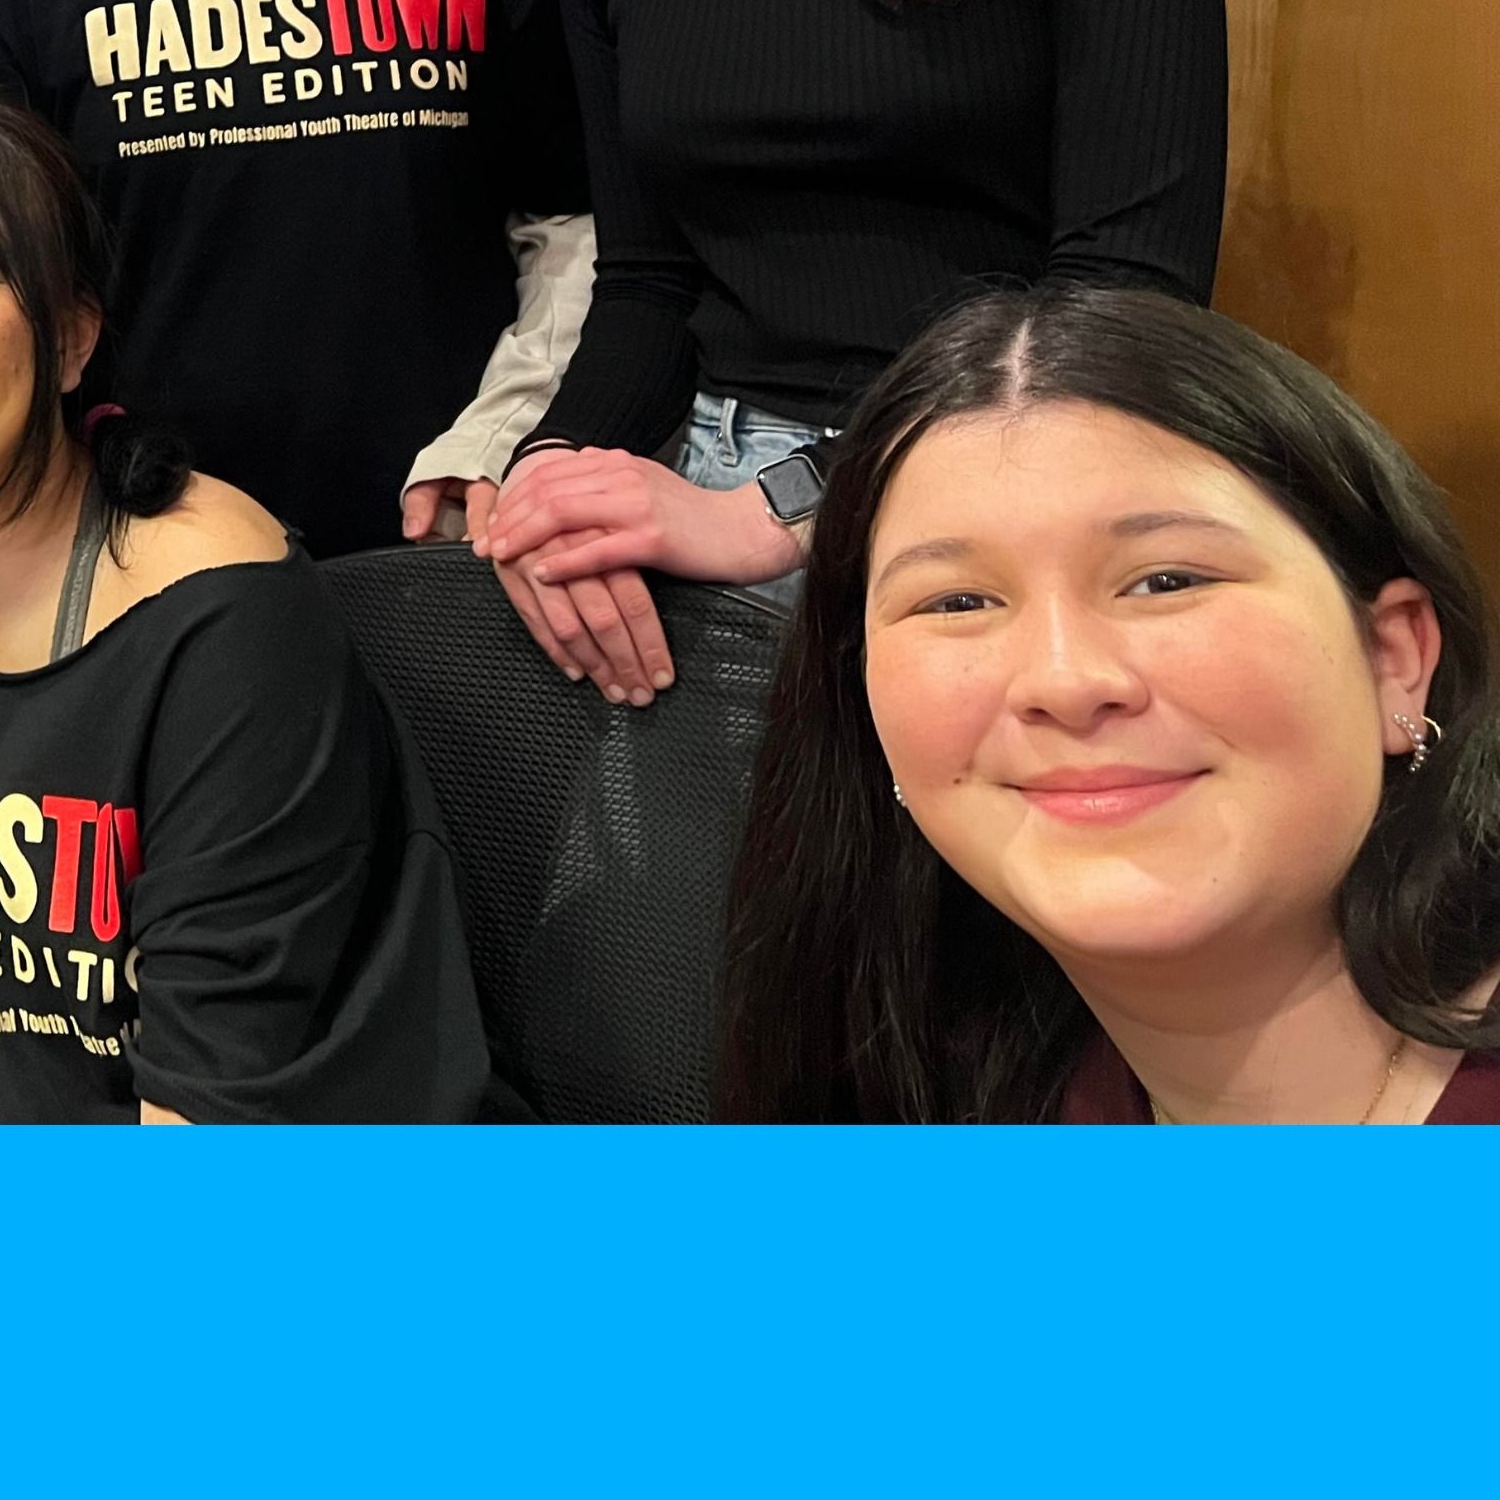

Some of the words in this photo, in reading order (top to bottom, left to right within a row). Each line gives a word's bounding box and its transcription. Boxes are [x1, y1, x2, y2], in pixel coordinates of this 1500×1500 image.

[112, 76, 234, 122] TEEN
[262, 58, 468, 104] EDITION
[118, 132, 185, 158] Presented
[188, 129, 205, 149] by
[210, 120, 297, 146] Professional
[301, 116, 340, 138] Youth
[344, 111, 398, 132] Theatre
[402, 109, 416, 127] of
[19, 1008, 69, 1035] Youth
